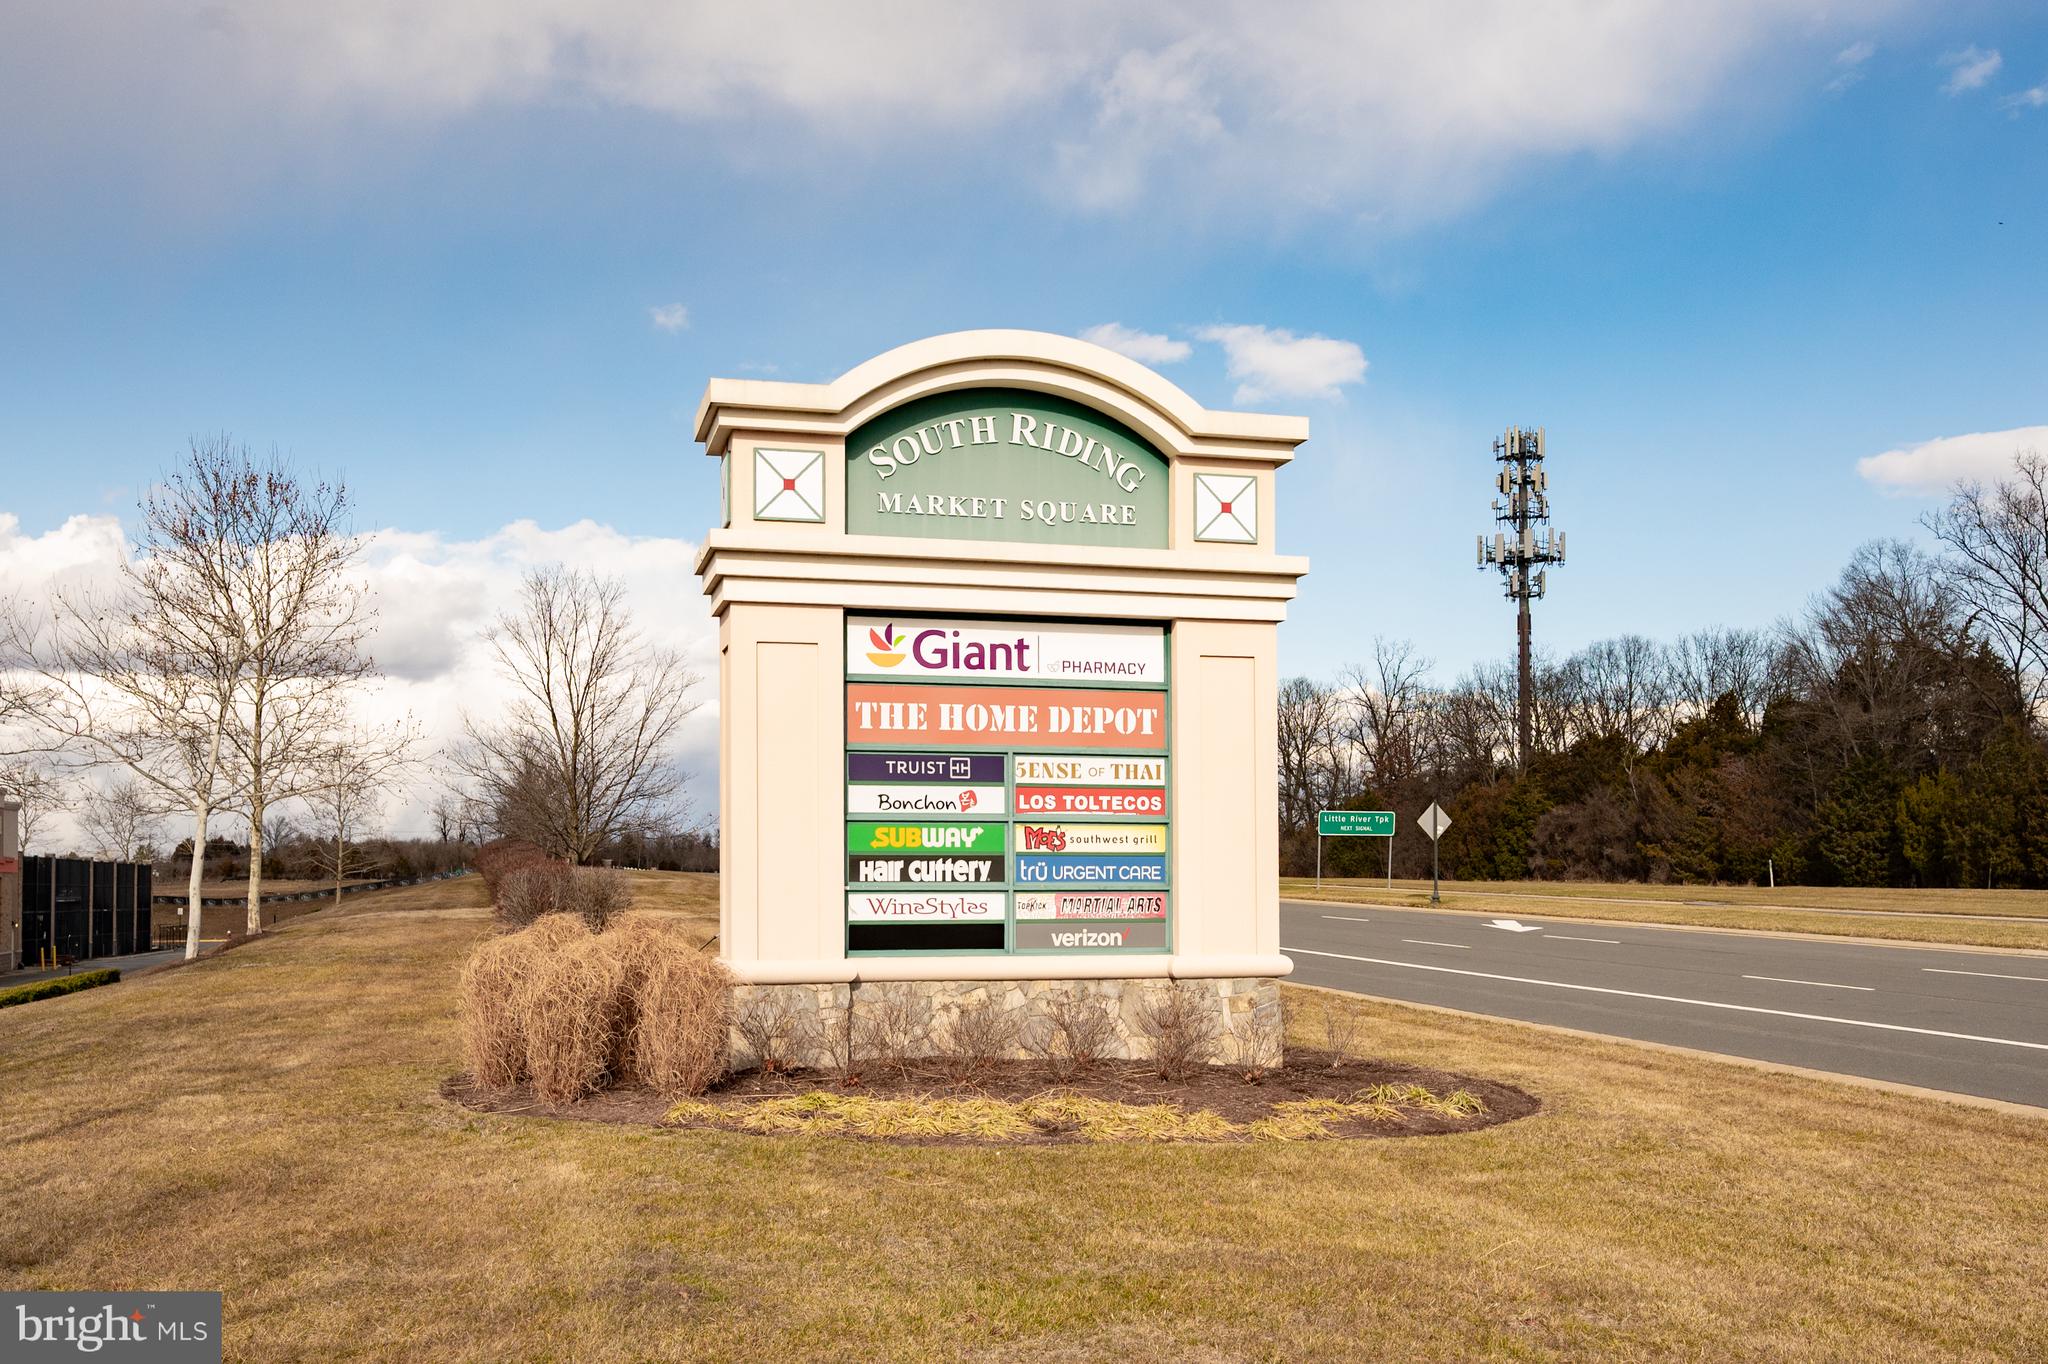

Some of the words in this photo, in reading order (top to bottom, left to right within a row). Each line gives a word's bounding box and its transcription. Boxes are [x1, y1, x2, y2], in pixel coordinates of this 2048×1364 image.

[868, 416, 999, 480] SOUTH
[1008, 413, 1146, 493] RIDING
[877, 492, 1007, 519] MARKET
[1020, 500, 1136, 526] SQUARE
[913, 629, 1030, 672] Giant
[1062, 660, 1146, 675] PHARMACY
[855, 701, 927, 729] THE
[939, 703, 1038, 732] HOME
[1048, 706, 1158, 735] DEPOT
[886, 761, 946, 774] TRUIST
[1089, 767, 1105, 777] OF
[1110, 764, 1161, 780] THAI
[878, 794, 956, 810] Bonchon
[1019, 795, 1056, 810] LOS
[1062, 796, 1161, 811] TOLTECOS
[1324, 815, 1346, 823] Little
[1350, 815, 1371, 823] River
[1375, 815, 1389, 824] Tpk
[870, 827, 984, 848] SUBWAY
[1070, 835, 1129, 844] southwest
[1133, 835, 1157, 845] grill
[1052, 866, 1116, 879] URGENT
[1119, 866, 1161, 879] CARE
[866, 898, 988, 918] WineStyles
[1061, 898, 1121, 913] MARTIAL
[1127, 897, 1161, 913] ARTS
[1051, 929, 1122, 946] verizon
